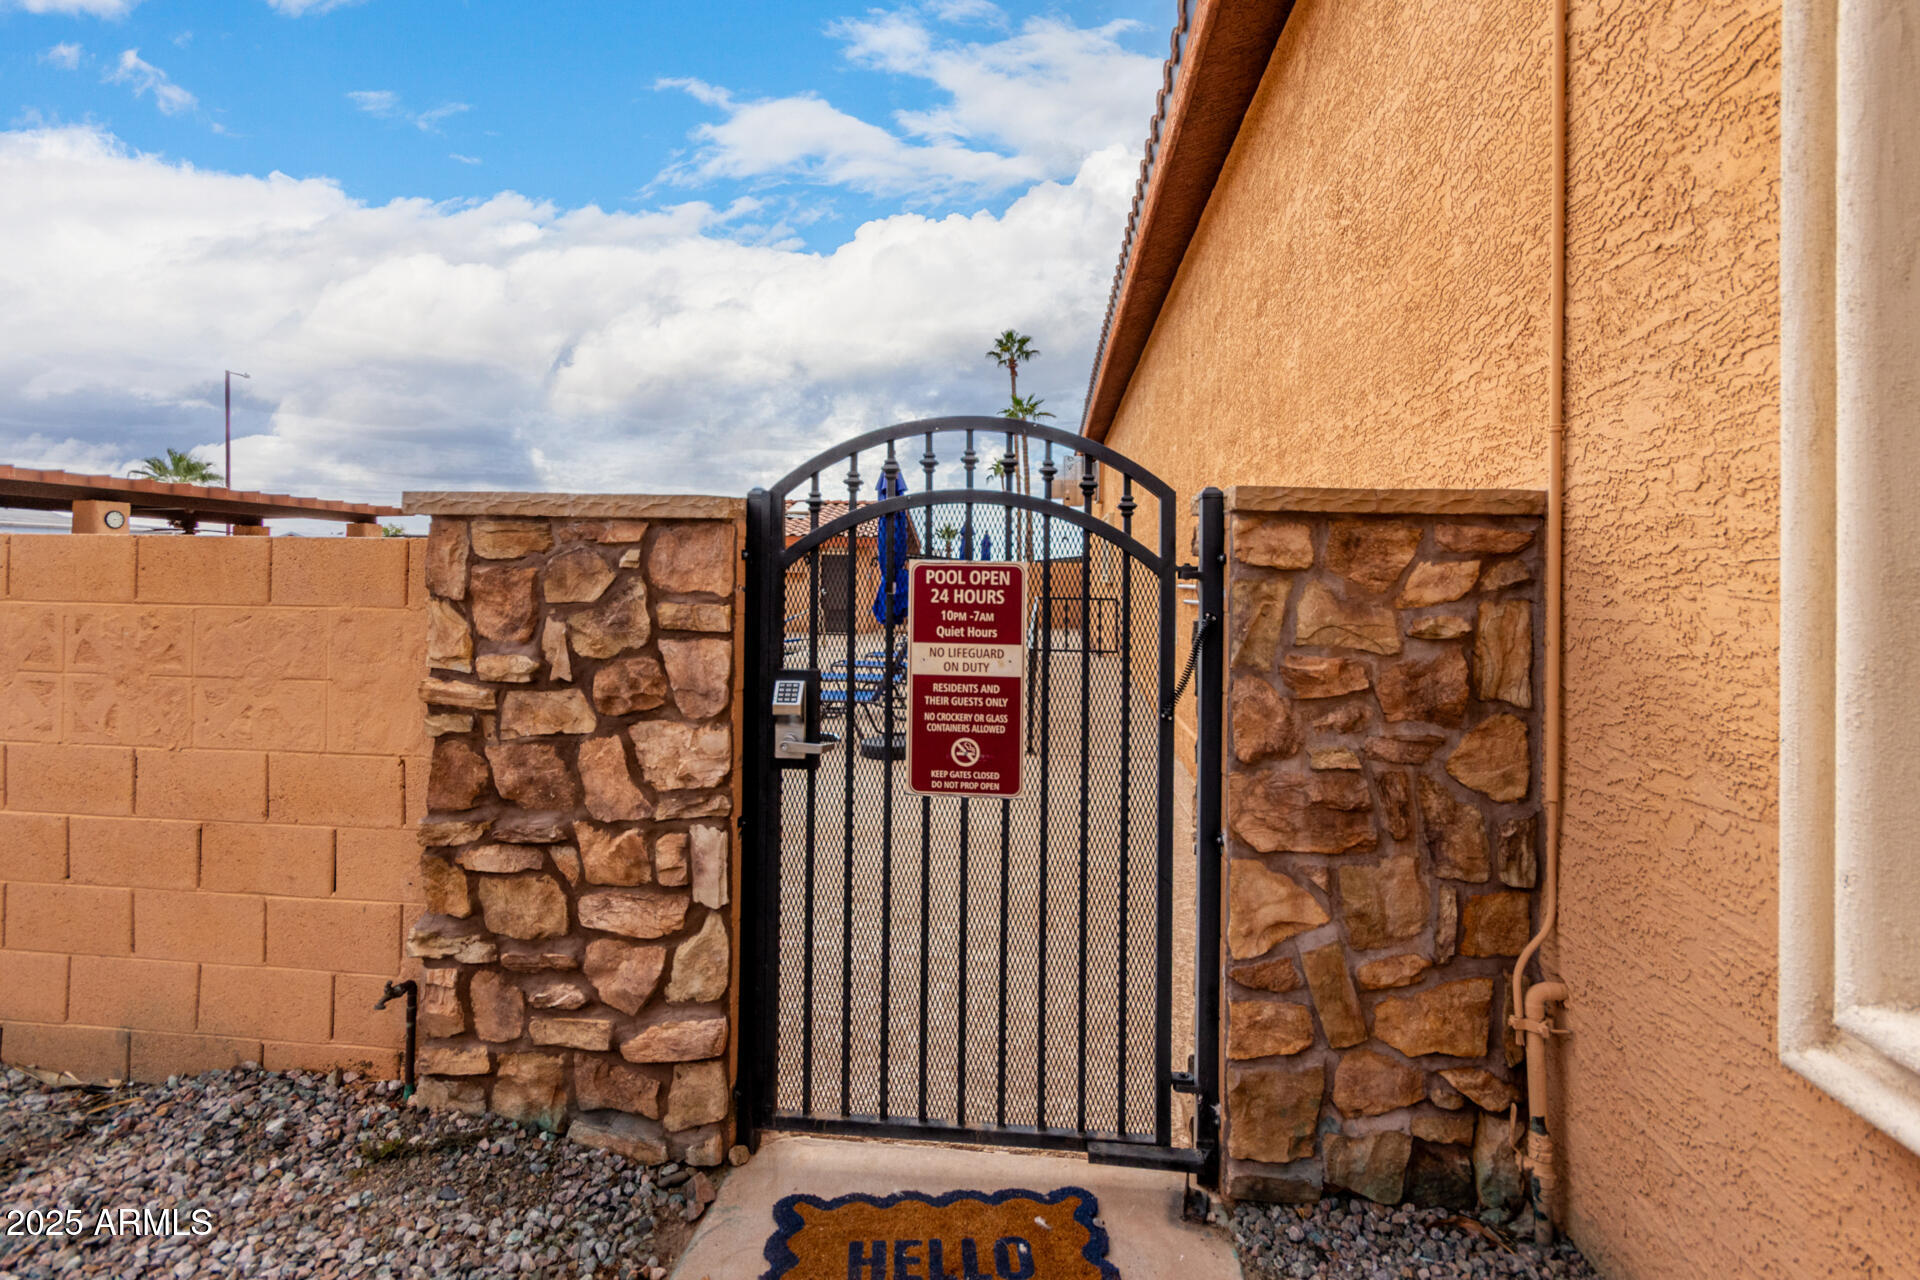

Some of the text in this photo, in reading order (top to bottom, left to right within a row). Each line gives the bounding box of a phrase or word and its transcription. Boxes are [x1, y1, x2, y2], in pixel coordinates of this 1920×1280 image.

[926, 569, 1010, 585] POOL OPEN
[931, 588, 1005, 604] 24 HOURS
[936, 625, 997, 639] Quiet Hours
[930, 647, 1004, 658] NO LIFEGUARD
[944, 661, 990, 672] ON DUTY
[933, 683, 1000, 693] RESIDENTS AND
[925, 695, 1008, 707] THEIR GUESTS ONLY
[924, 712, 1008, 723] NO CROCKERY OR GLASS
[927, 723, 1005, 733] CONTAINERS ALLOWED
[931, 769, 1000, 779] KEEP GATES CLOSED
[932, 780, 999, 790] DO NOT PROP OPEN
[848, 1236, 1035, 1280] HELLO
